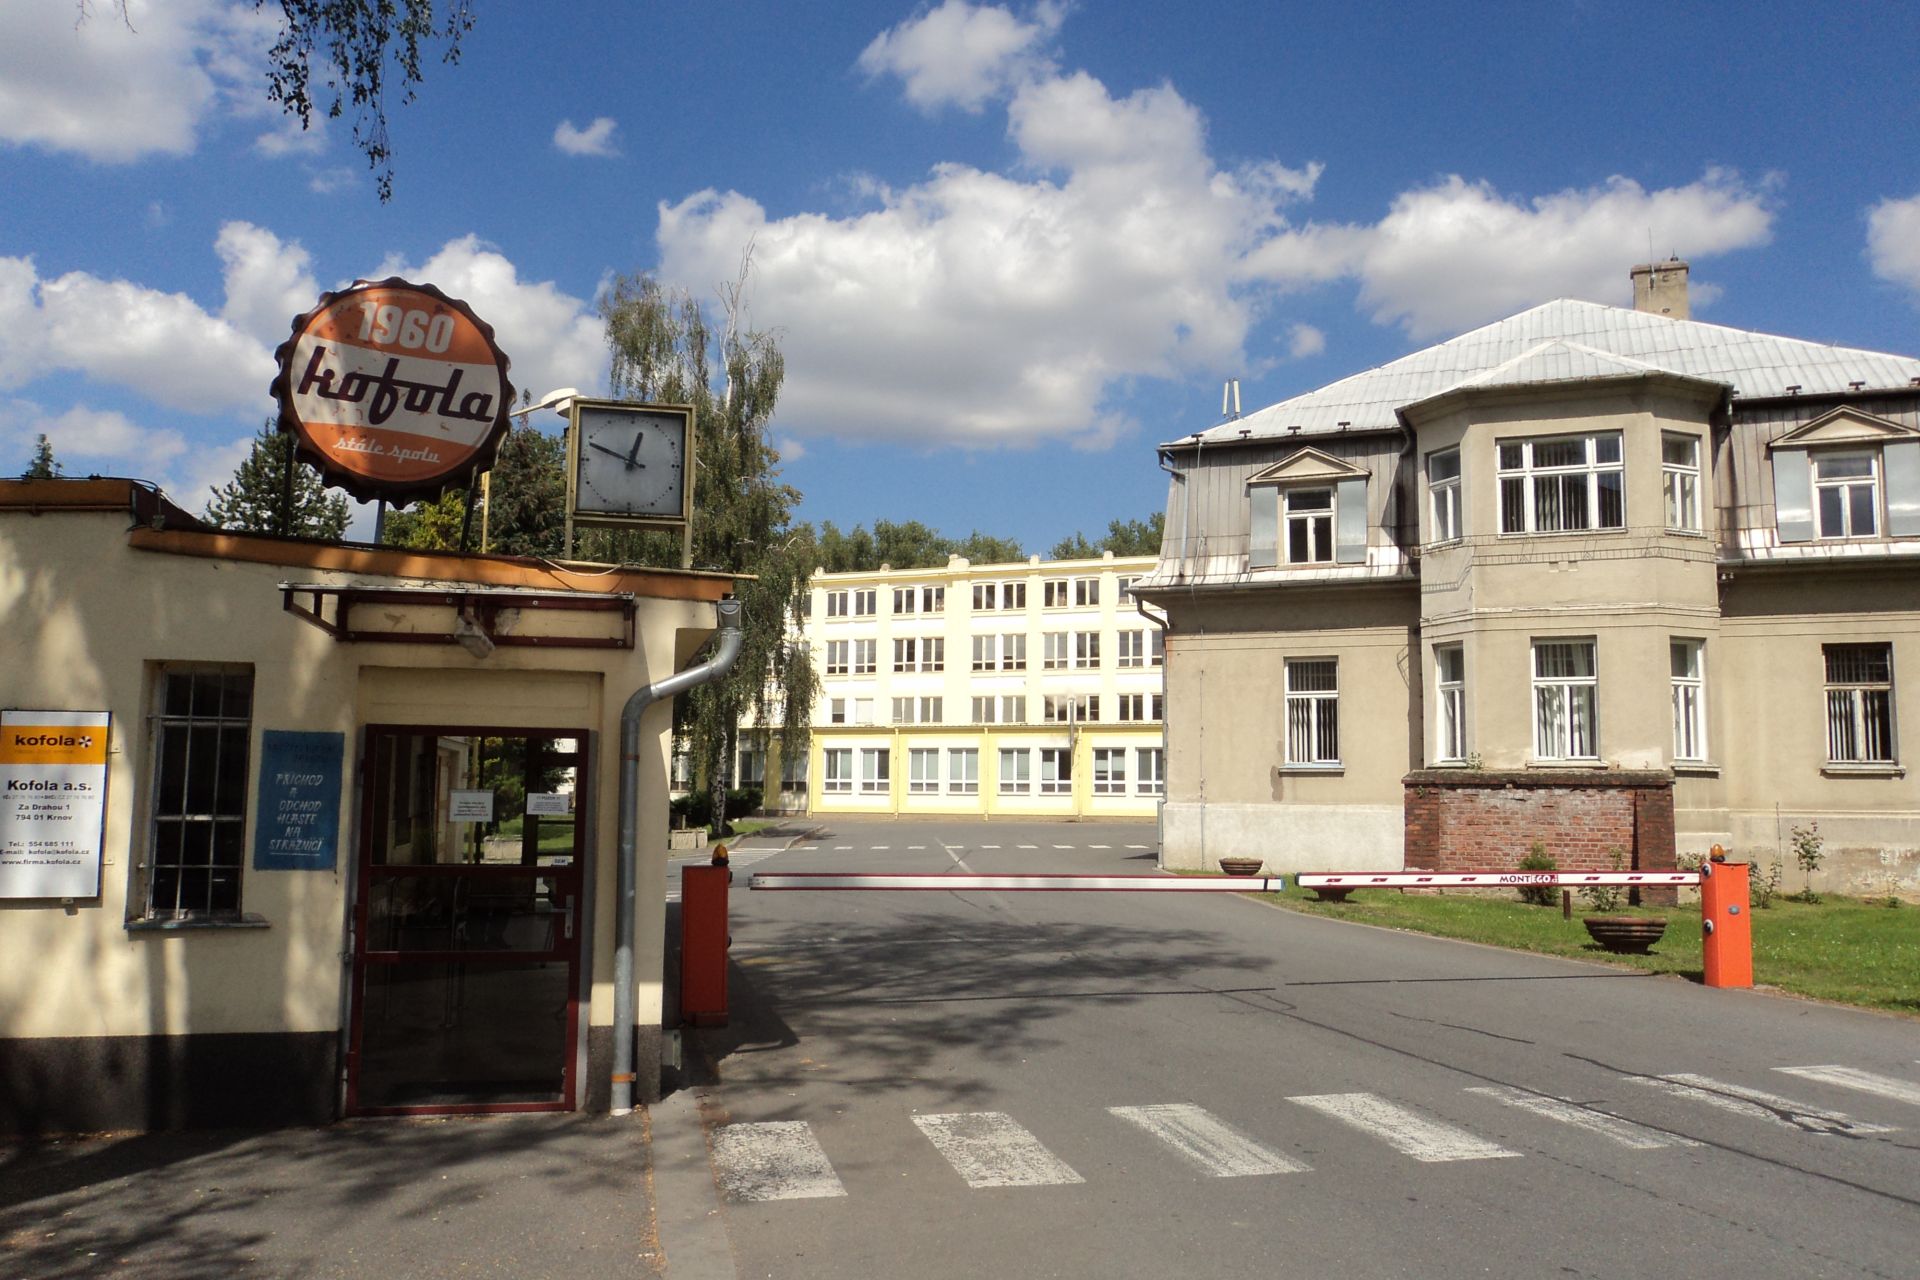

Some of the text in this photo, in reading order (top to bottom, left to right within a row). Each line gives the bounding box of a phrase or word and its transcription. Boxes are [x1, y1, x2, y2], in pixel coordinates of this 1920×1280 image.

[357, 301, 455, 354] 1960
[297, 346, 494, 425] kofola
[332, 437, 441, 464] stále spolu
[15, 734, 75, 746] kofola
[7, 780, 92, 791] Kofola a.s.
[279, 800, 322, 812] ODCHOD
[285, 826, 302, 838] NA
